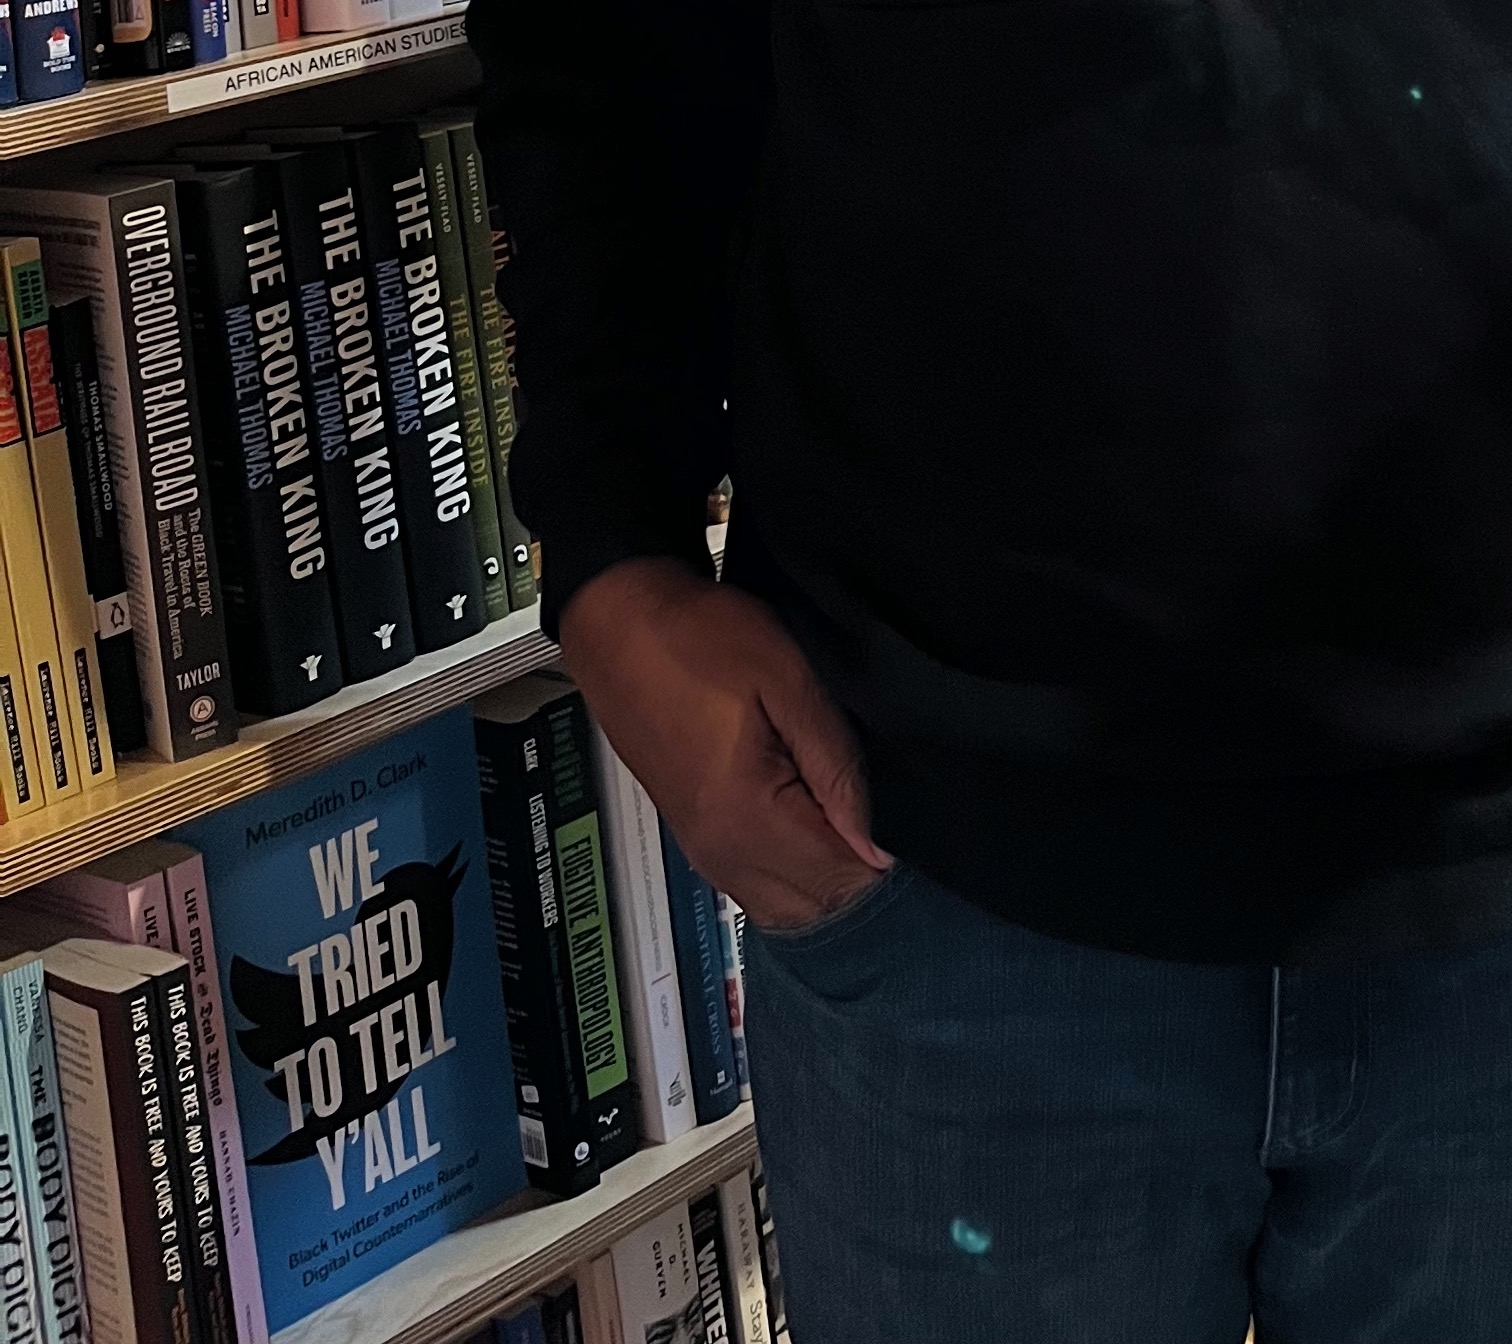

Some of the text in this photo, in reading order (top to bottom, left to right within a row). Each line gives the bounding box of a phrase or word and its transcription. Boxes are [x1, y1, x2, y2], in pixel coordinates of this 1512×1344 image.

[225, 18, 468, 93] AFRICAN AMERICAN STUDIES
[122, 204, 198, 511] OVERGROUND RAILROAD
[393, 167, 471, 523] THE BROKEN KING
[176, 662, 221, 691] TAYLOR
[245, 751, 428, 848] Meredith D. Clark
[309, 816, 385, 920] WE
[561, 833, 597, 930] FUGITIVE
[288, 899, 423, 1027] TRIED
[571, 924, 618, 1075] ANTHROPOLOGY
[274, 1036, 343, 1133] TO
[350, 979, 457, 1095] TELL
[315, 1085, 441, 1211] Y'ALL
